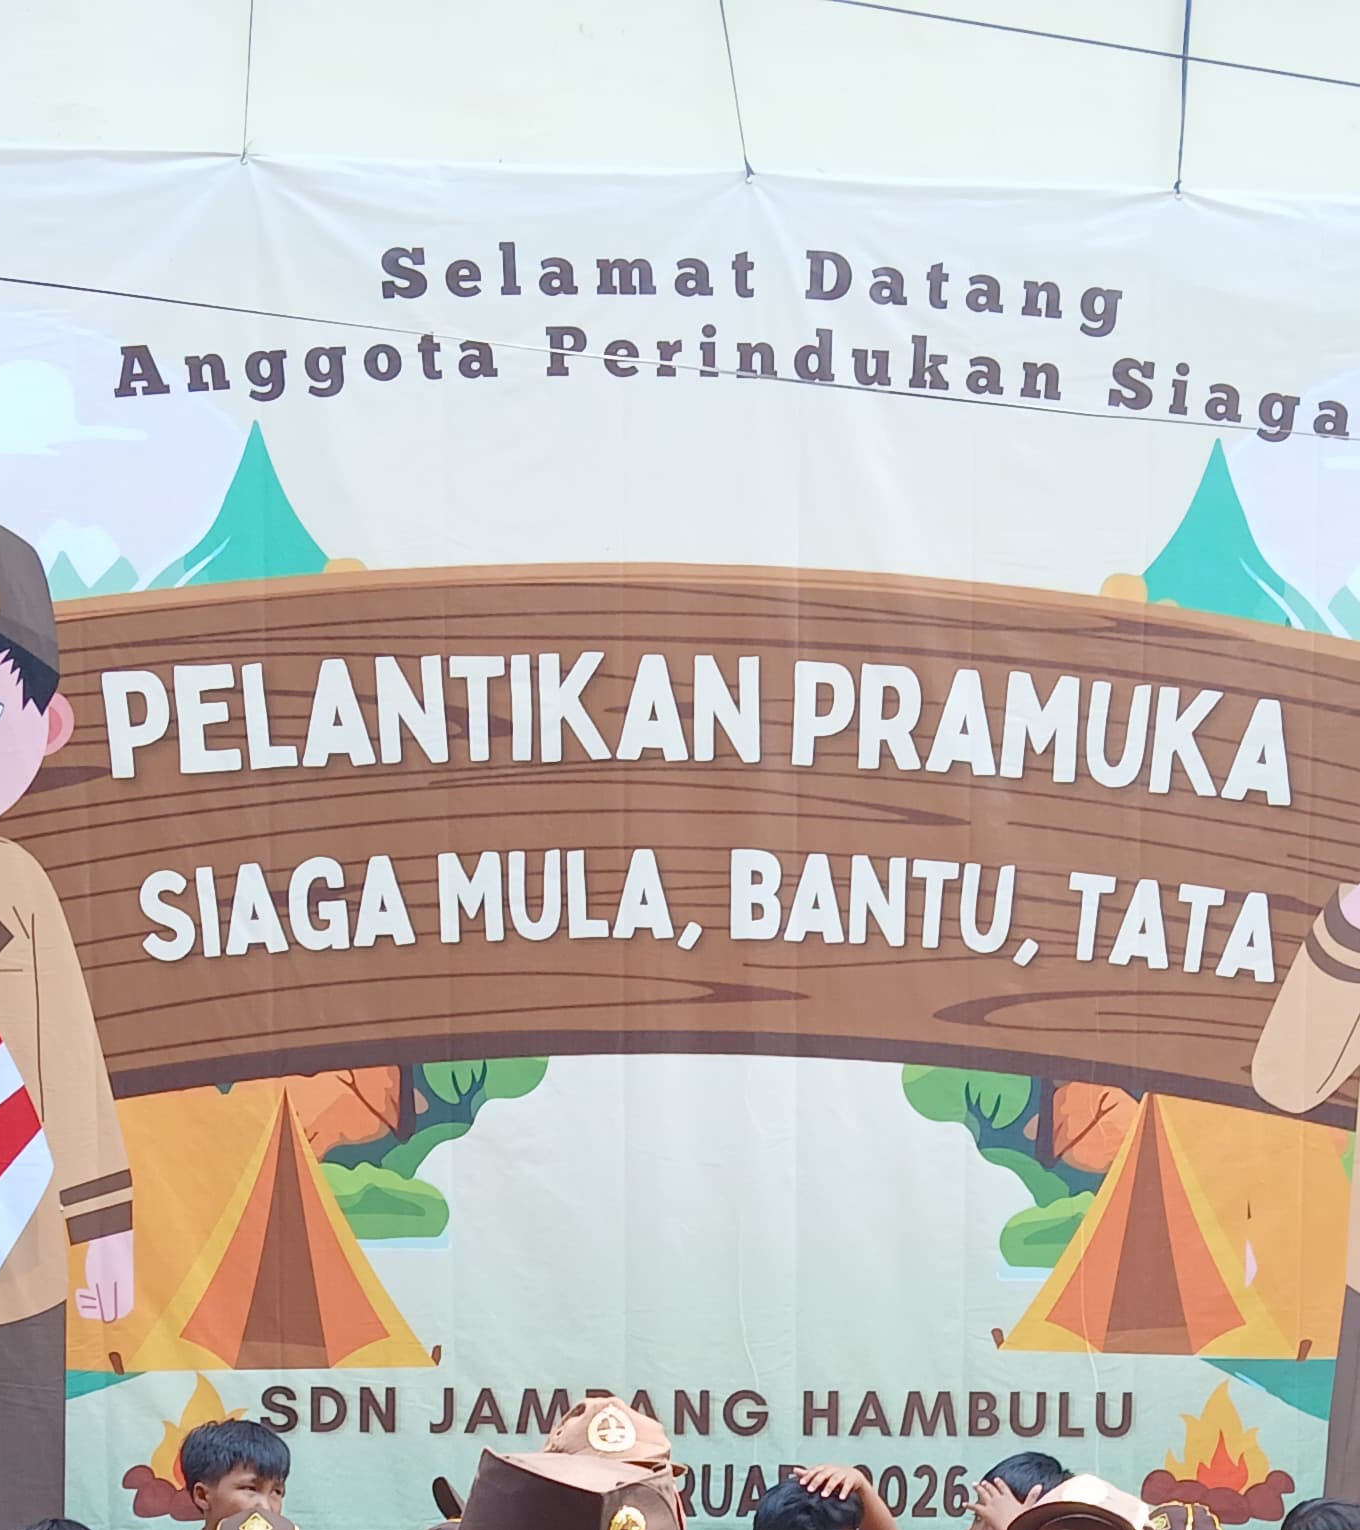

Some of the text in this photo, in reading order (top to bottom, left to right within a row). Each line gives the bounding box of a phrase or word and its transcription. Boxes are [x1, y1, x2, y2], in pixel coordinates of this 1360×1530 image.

[380, 244, 1123, 338] Selamat Datang
[113, 324, 1351, 443] Anggota Perindukan Siaga
[100, 650, 1292, 808] PELANTIKAN PRAMUKA
[138, 847, 1276, 984] SIAGA MULA, BANTU, TATA
[260, 1385, 1135, 1439] SDN JAMANG HAMBULU
